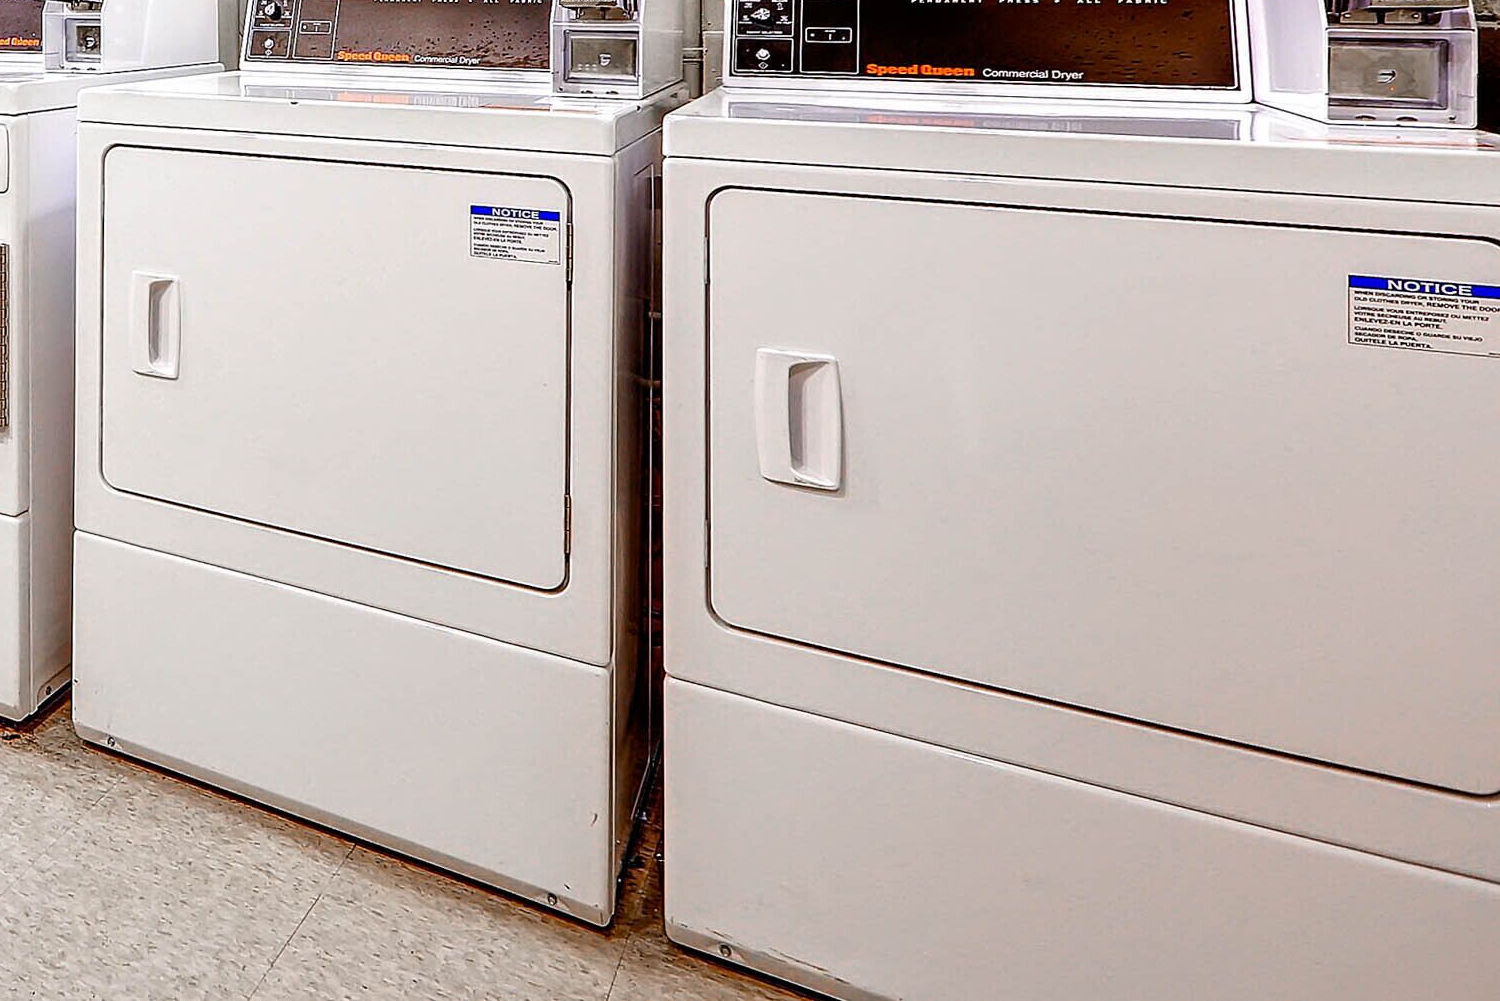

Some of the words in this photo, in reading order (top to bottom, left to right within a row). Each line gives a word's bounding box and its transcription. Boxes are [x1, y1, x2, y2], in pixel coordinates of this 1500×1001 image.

[11, 37, 40, 46] Queen
[337, 51, 372, 62] Speed
[373, 52, 410, 62] Queen
[414, 54, 458, 64] Commercial
[459, 55, 481, 65] Dryer
[866, 64, 918, 76] Speed
[920, 64, 975, 77] Queen
[982, 67, 1049, 79] Commercial
[1051, 69, 1084, 81] Dryer
[492, 207, 540, 220] NOTICE
[1387, 279, 1472, 296] NOTICE
[1426, 301, 1460, 309] REMOVE
